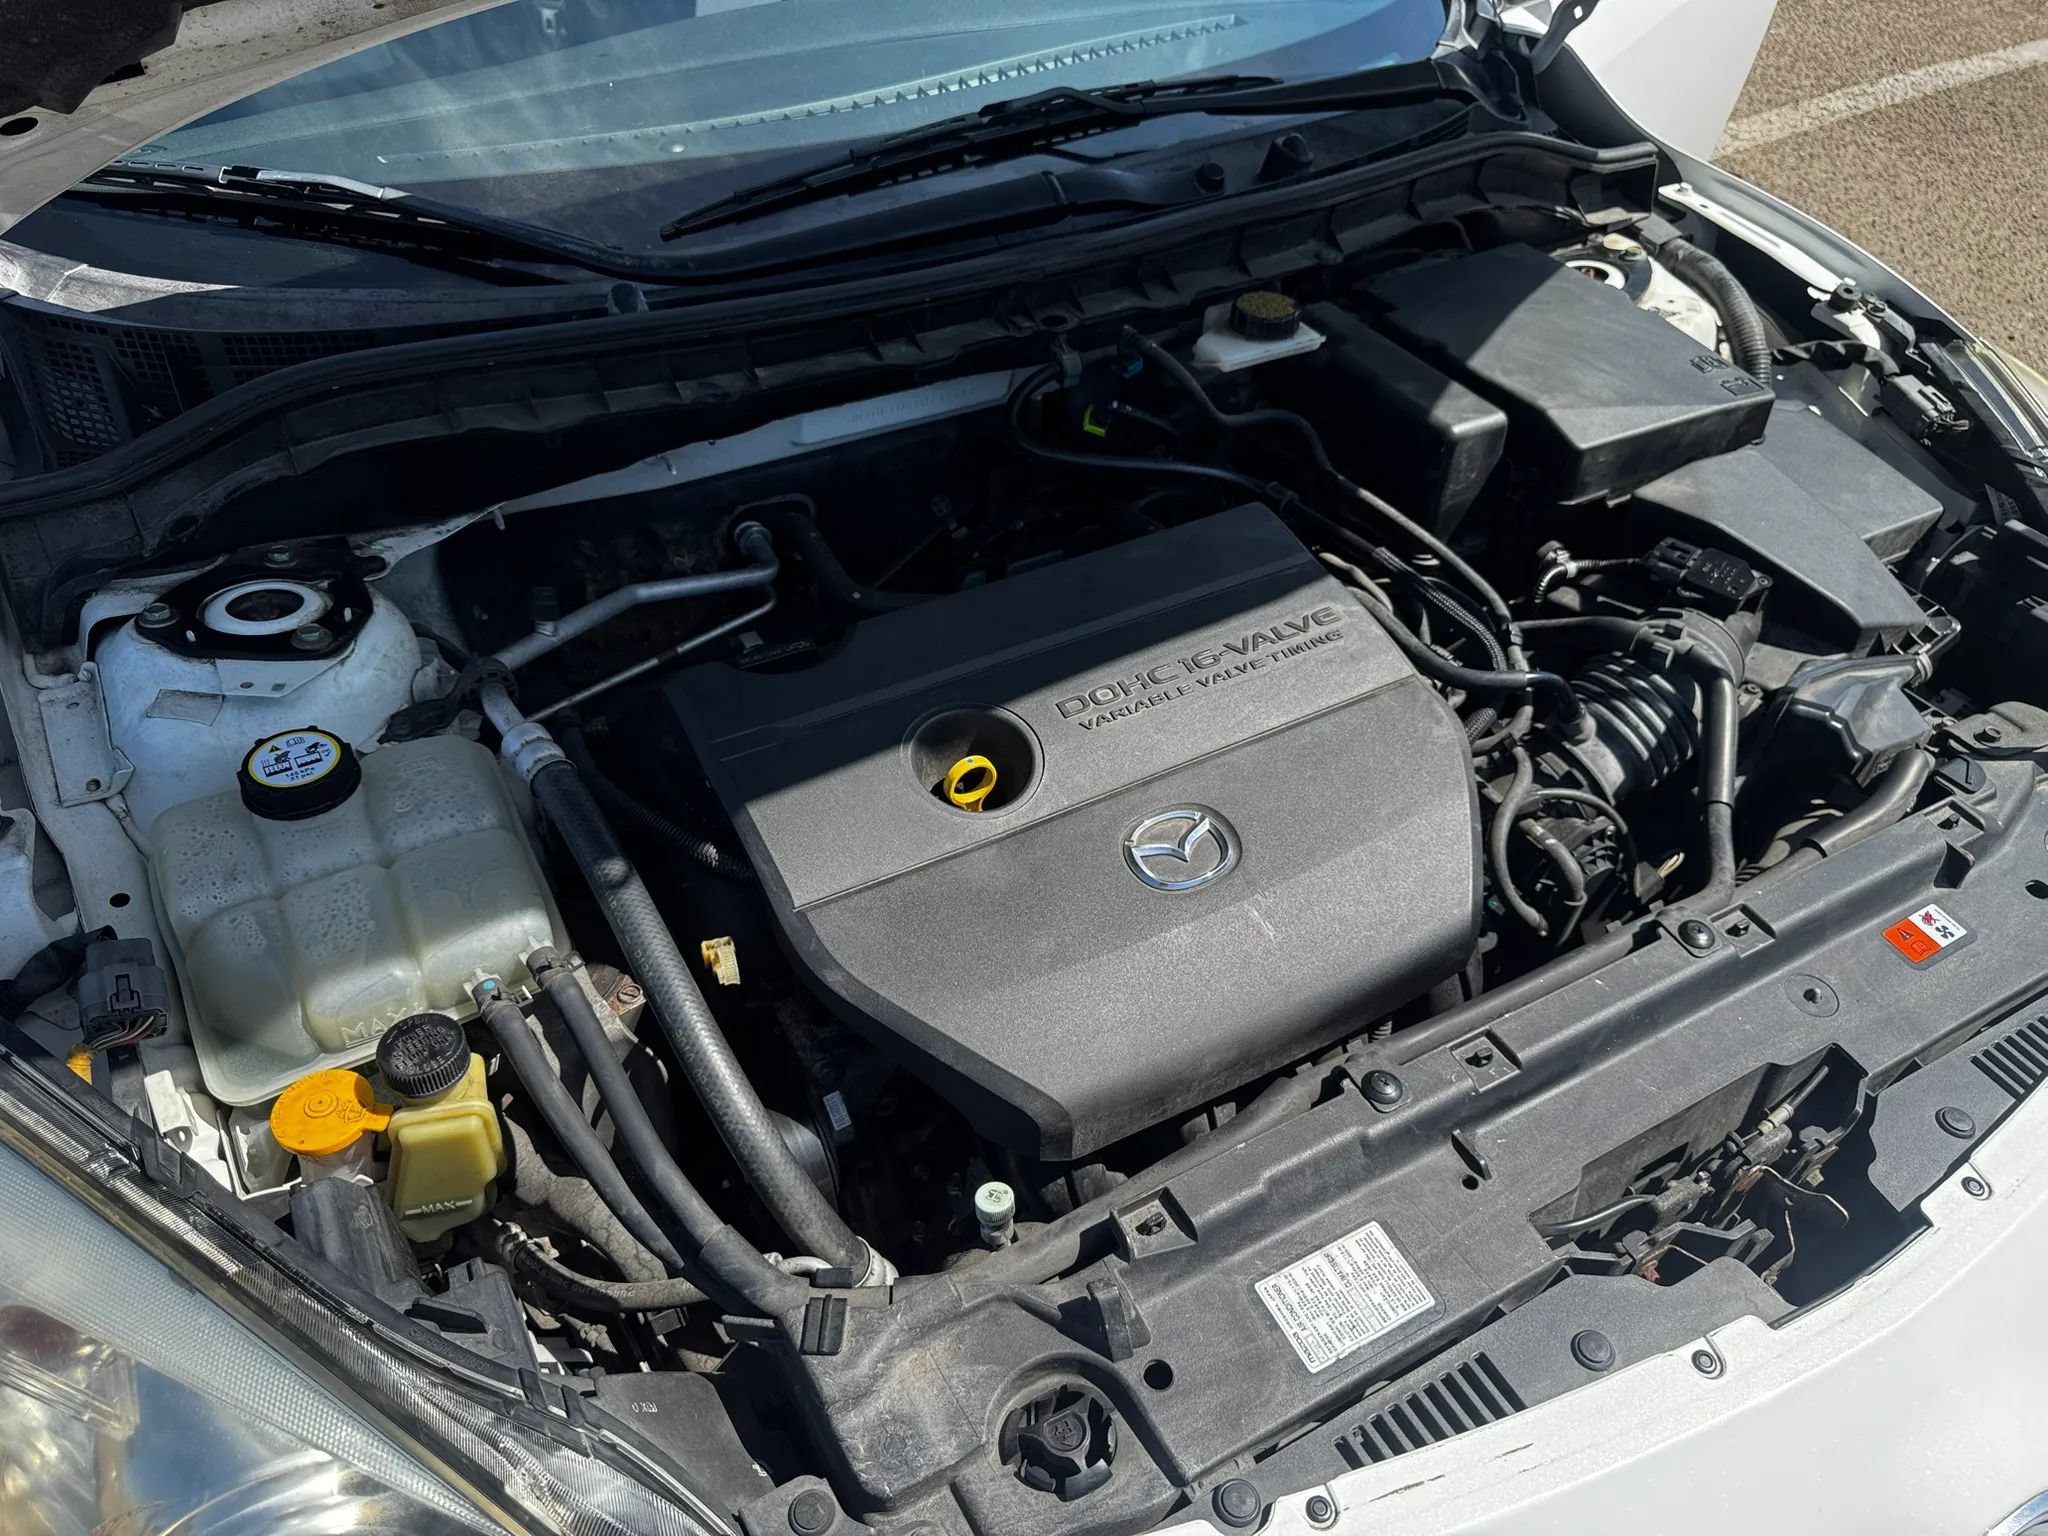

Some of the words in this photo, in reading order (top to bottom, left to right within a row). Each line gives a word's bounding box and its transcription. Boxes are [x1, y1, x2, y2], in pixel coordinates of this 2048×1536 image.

[1054, 663, 1182, 719] DOHC
[1178, 606, 1343, 675] 16-VALVE
[1077, 682, 1195, 731] VARIABLE
[1196, 658, 1267, 689] VALVE
[1268, 629, 1345, 663] TIMING
[341, 1007, 407, 1042] MAX
[421, 1200, 456, 1215] MAX
[1270, 1282, 1301, 1321] CONDITIONER
[1295, 1319, 1307, 1332] AIR
